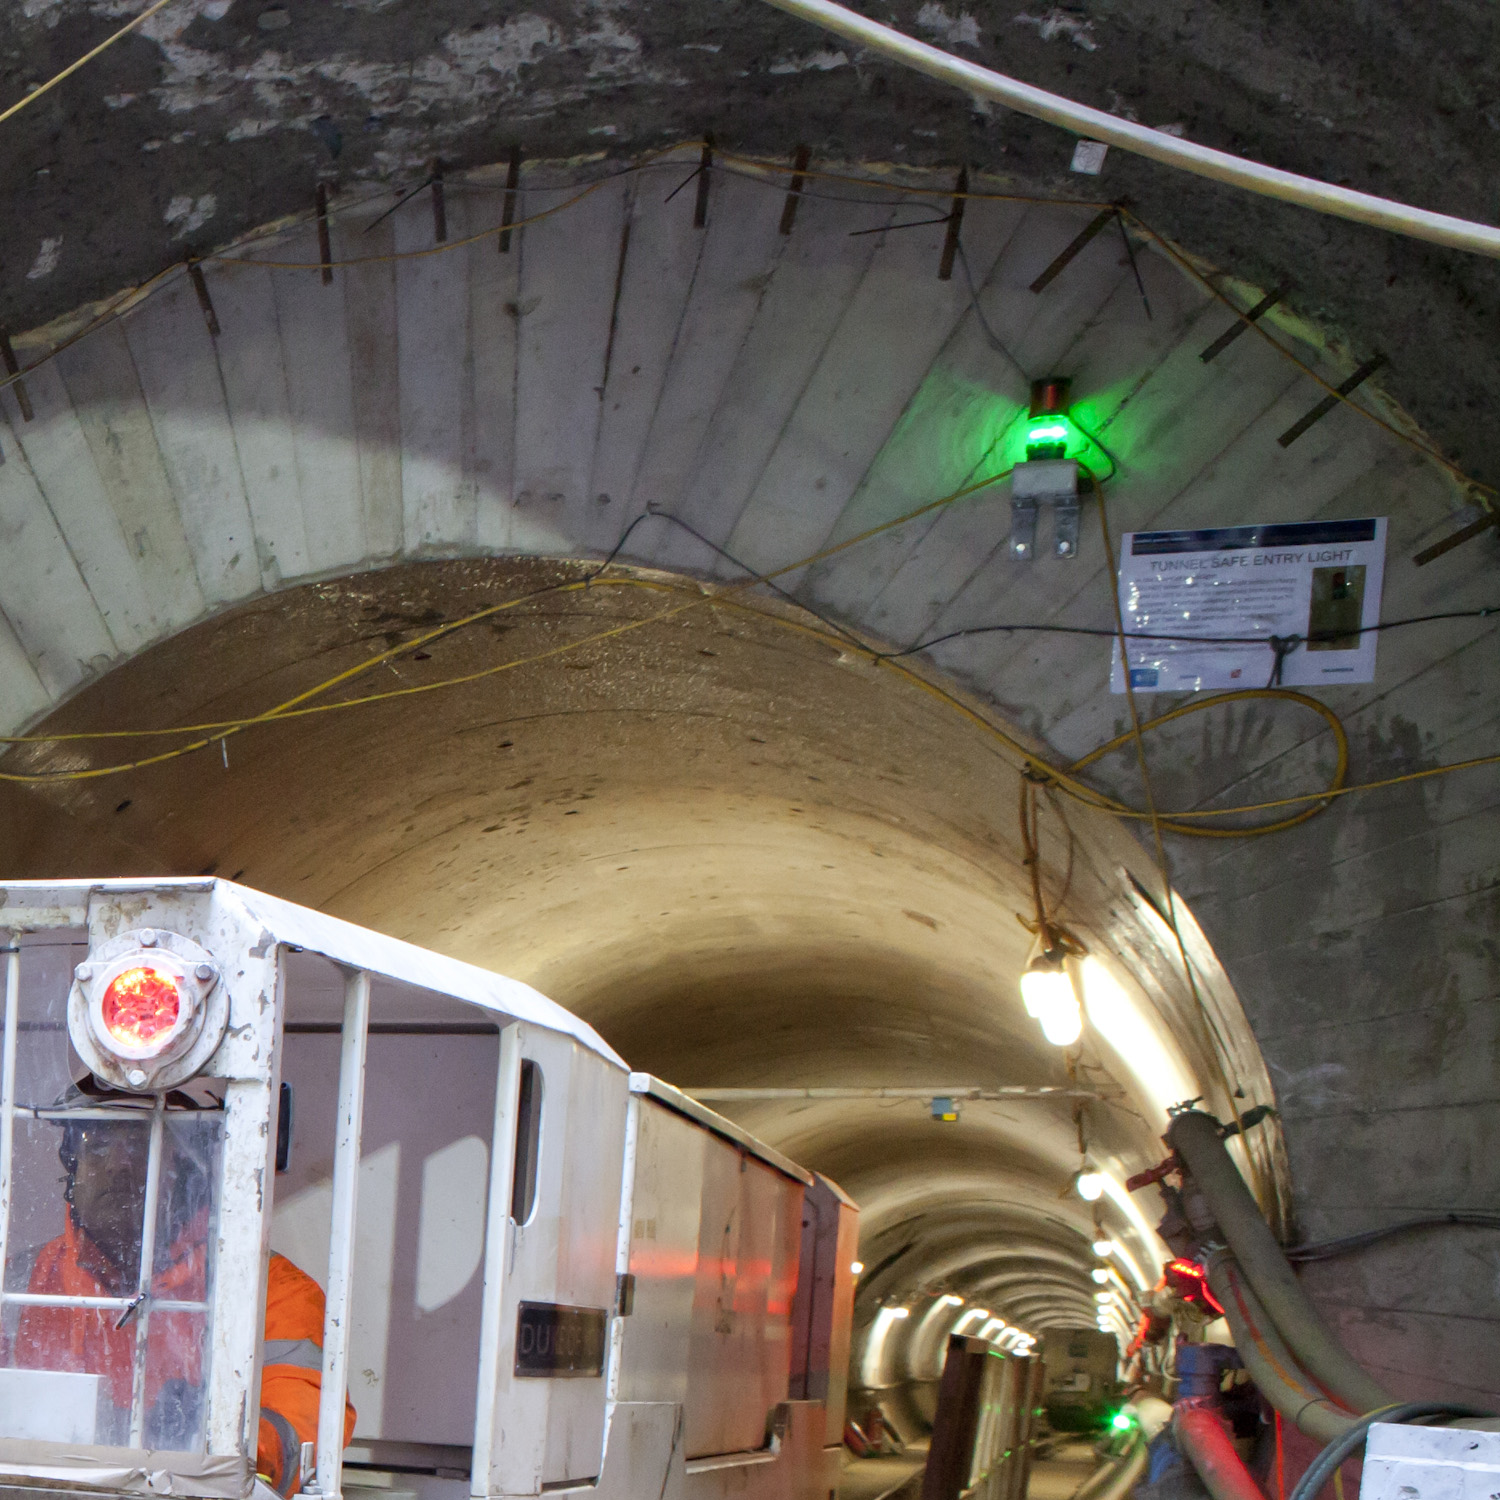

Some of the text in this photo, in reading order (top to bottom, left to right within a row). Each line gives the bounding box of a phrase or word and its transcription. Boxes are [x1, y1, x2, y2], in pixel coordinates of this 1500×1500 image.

[1151, 549, 1353, 572] TUNNEL SAFE ENTRY LIGHT
